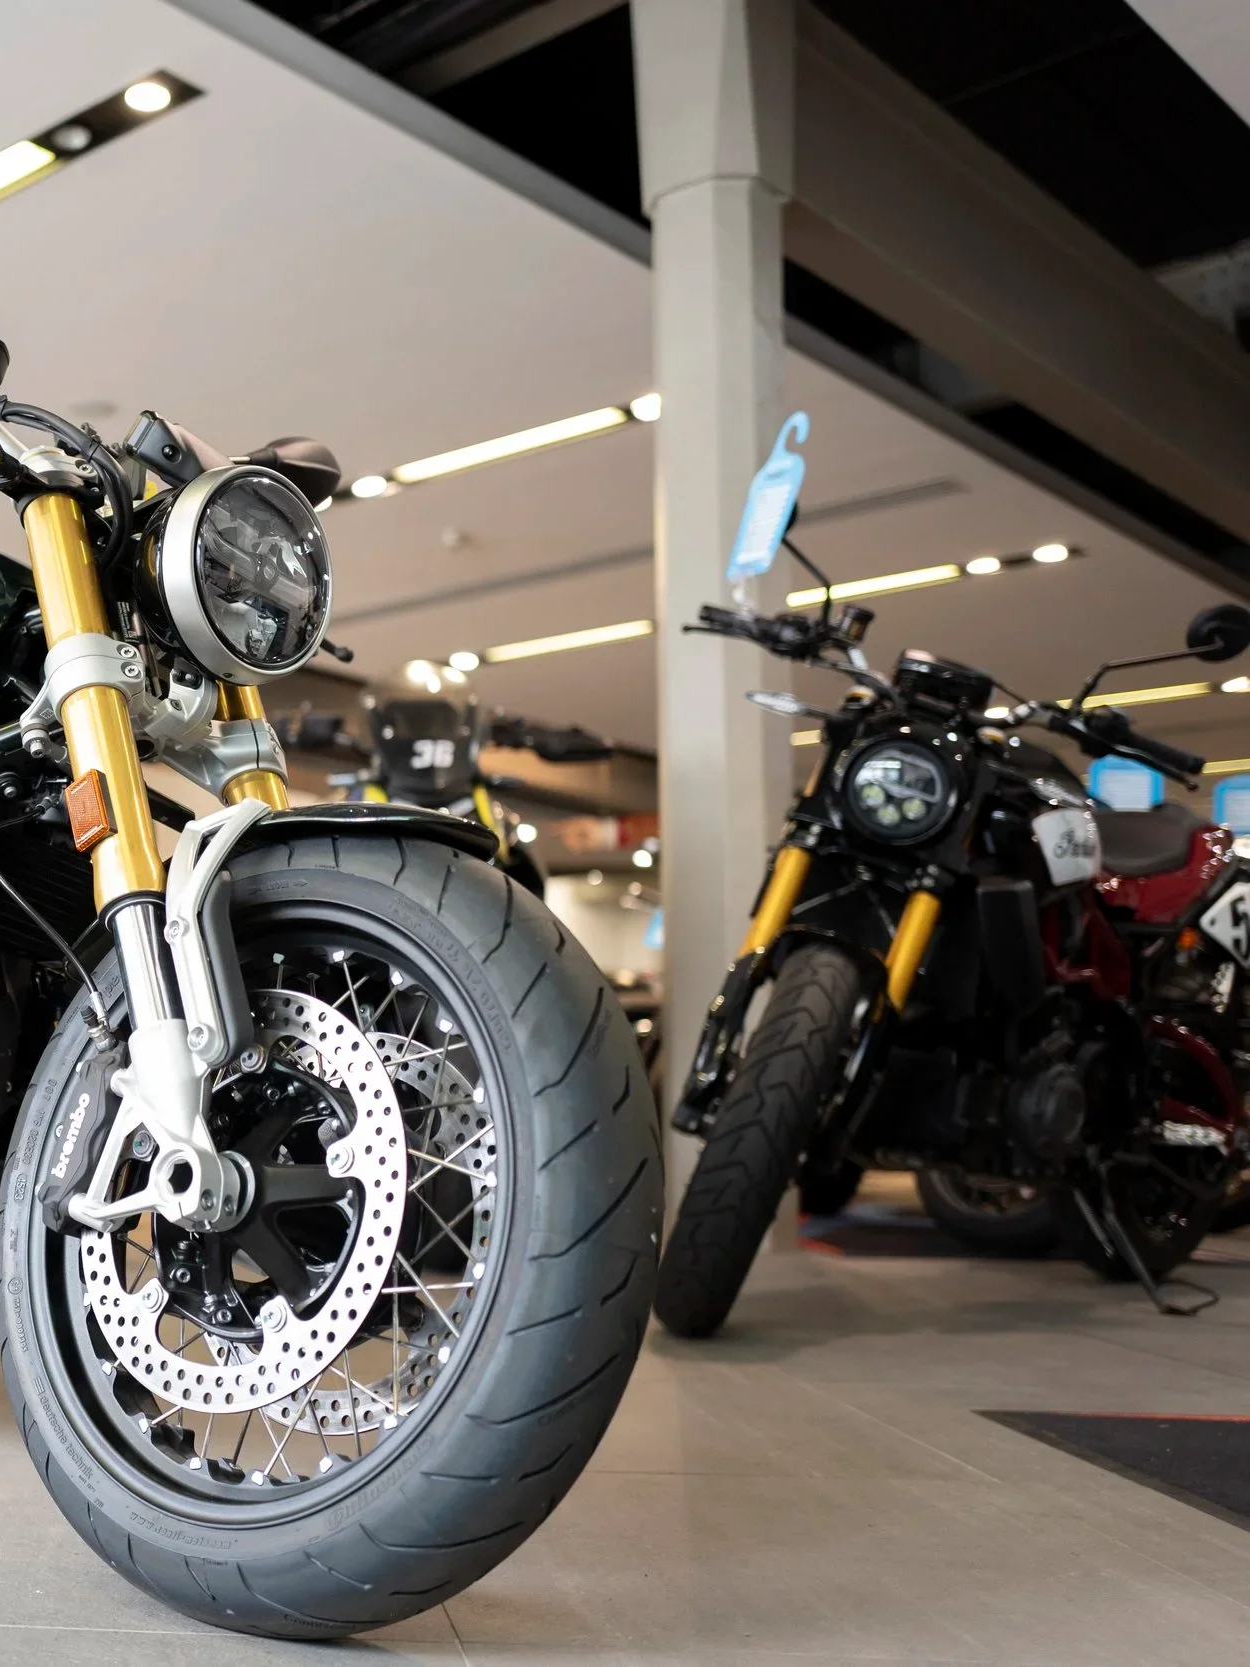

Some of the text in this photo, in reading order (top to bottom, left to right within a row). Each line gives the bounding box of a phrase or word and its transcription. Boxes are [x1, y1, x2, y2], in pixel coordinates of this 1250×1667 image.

[51, 1093, 90, 1179] brembo
[40, 1395, 94, 1480] deutsche technik
